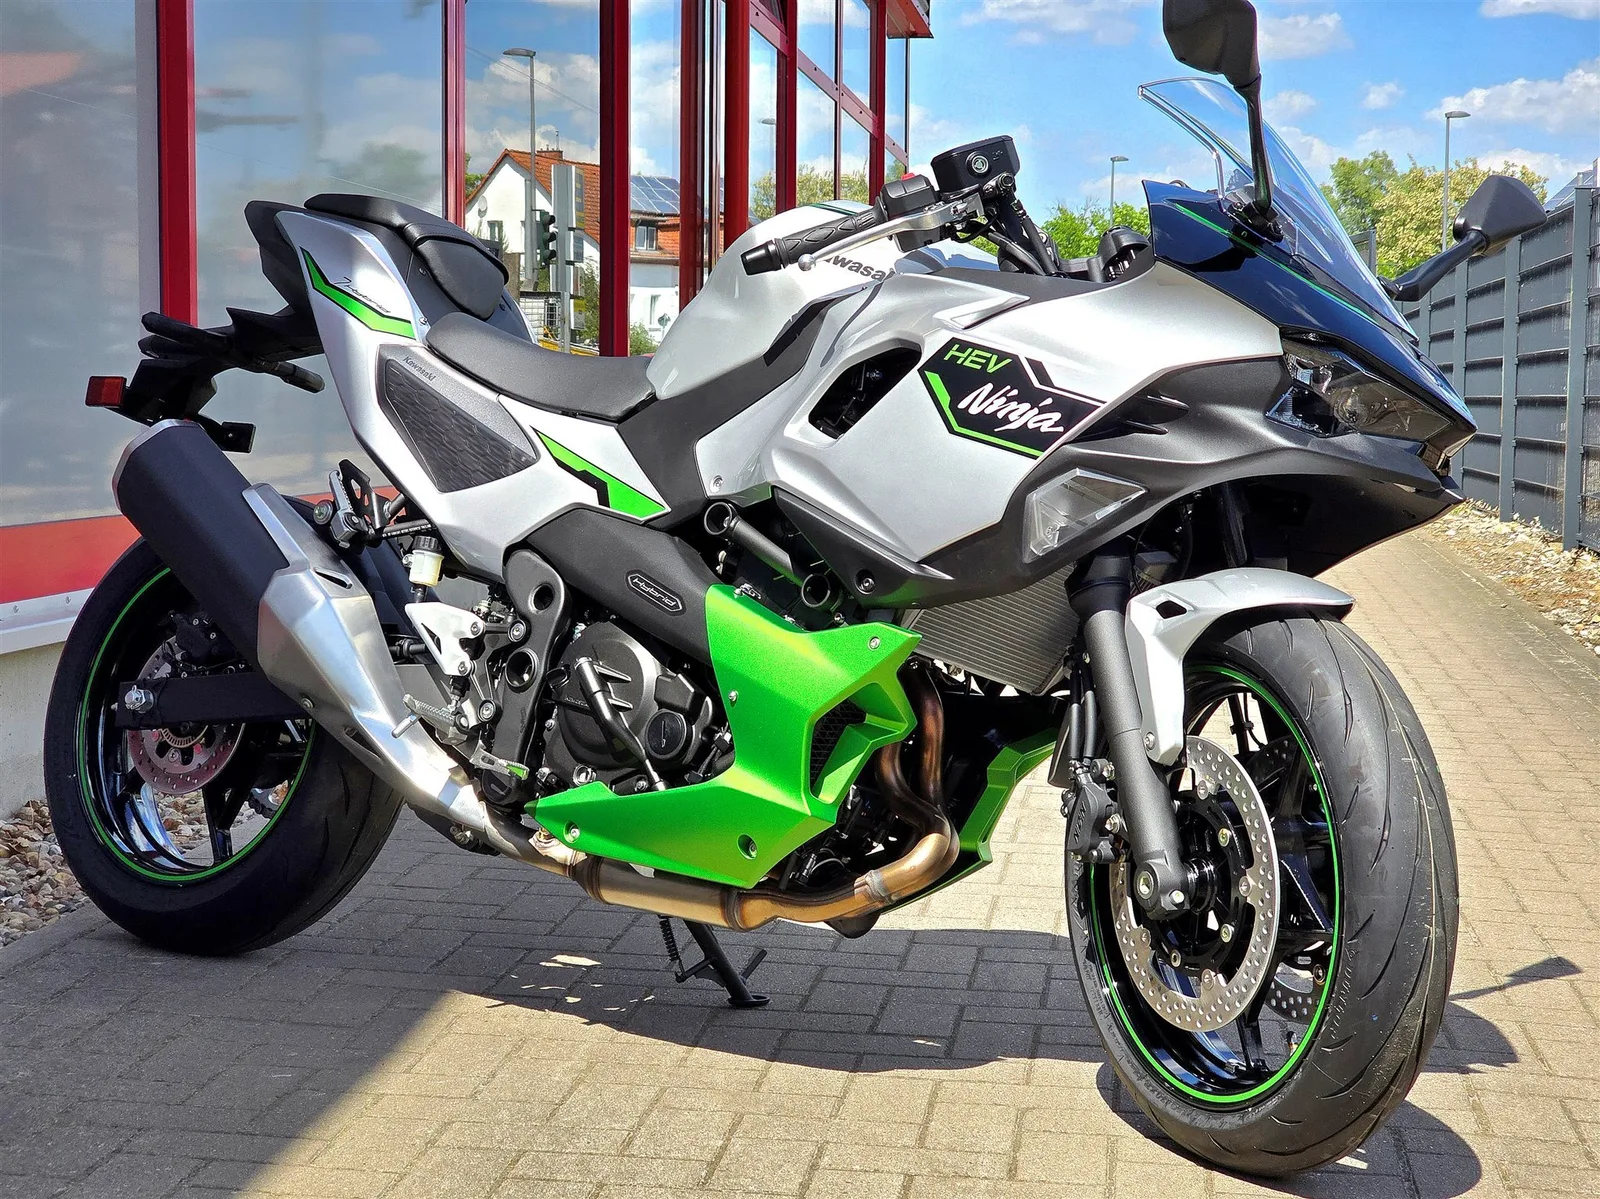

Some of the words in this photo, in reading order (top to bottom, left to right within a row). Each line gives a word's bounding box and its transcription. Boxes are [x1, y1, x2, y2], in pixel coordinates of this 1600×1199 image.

[402, 355, 437, 382] Kawasaki
[943, 343, 1012, 374] HEV
[957, 382, 1065, 433] Ninja
[632, 577, 677, 607] Hybrid
